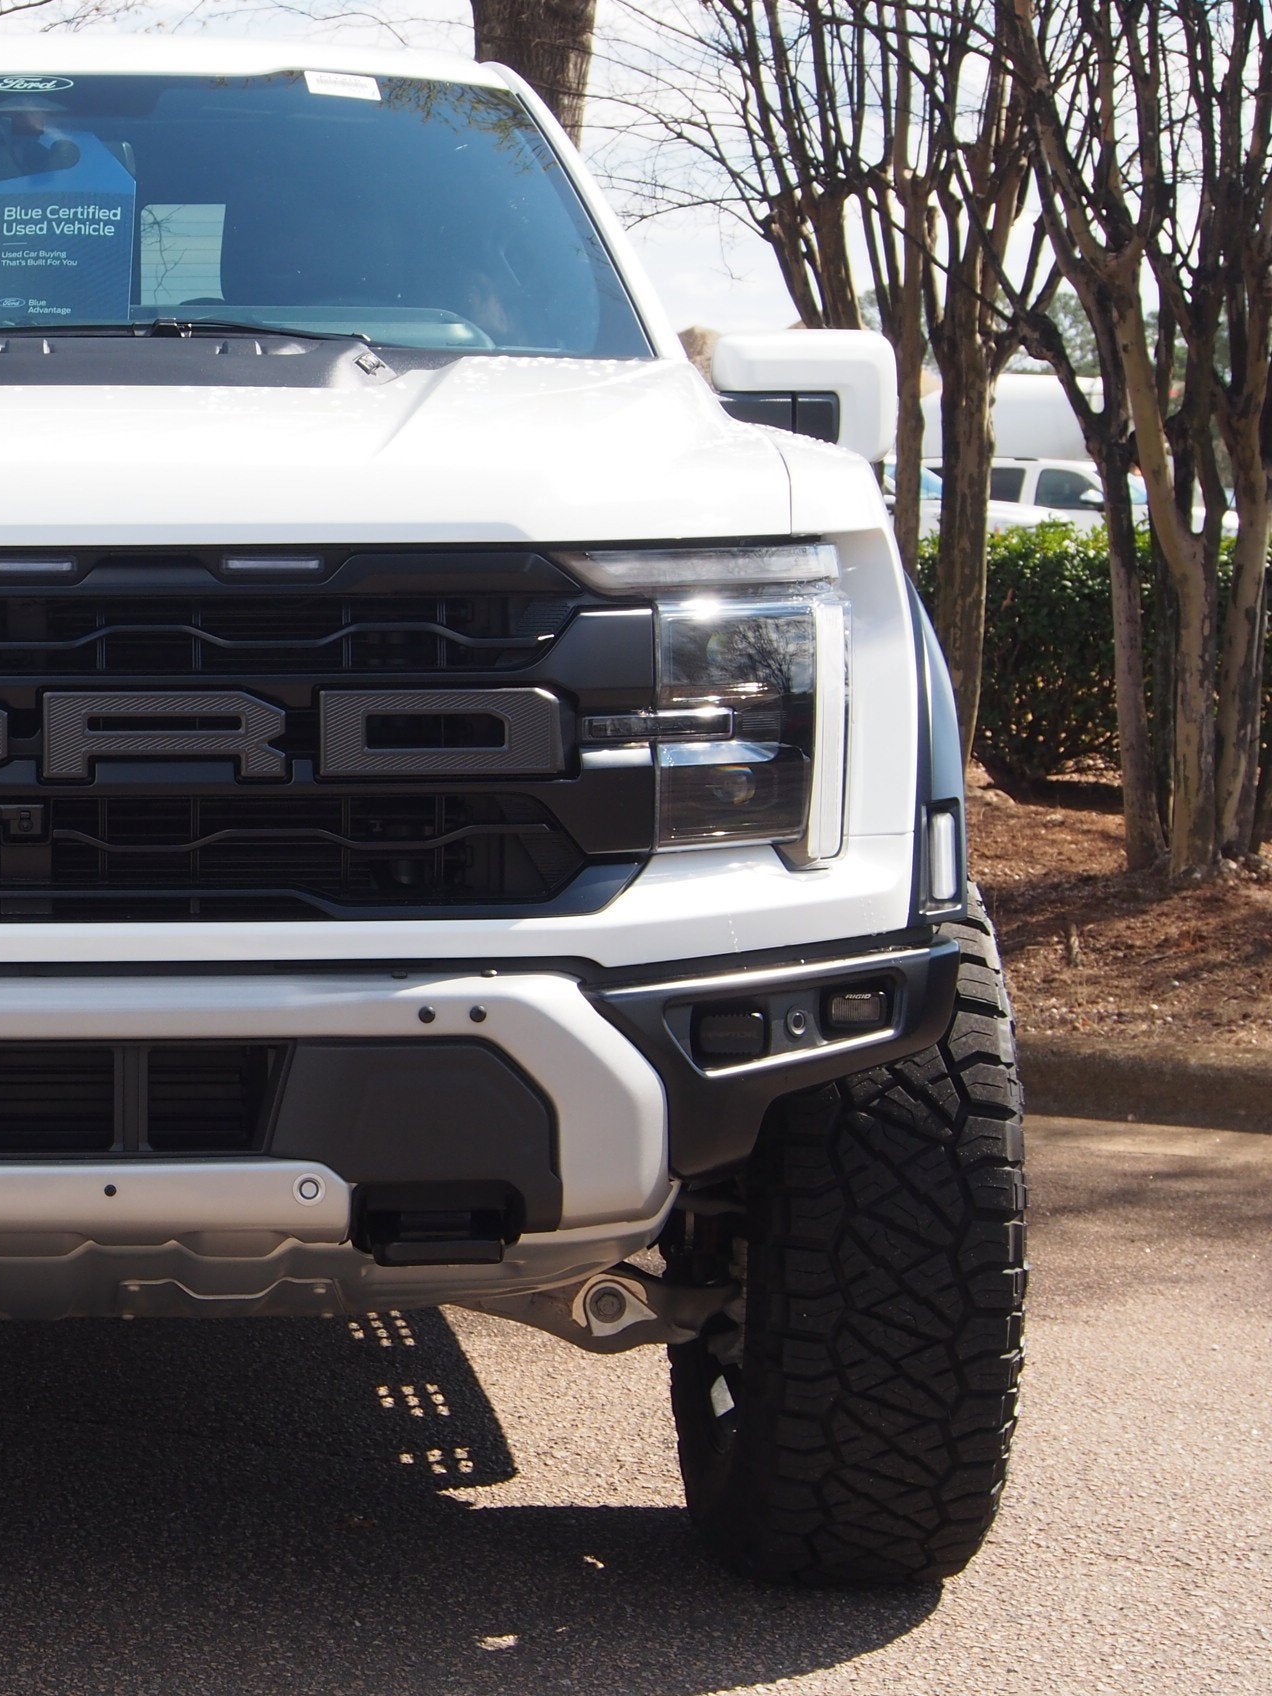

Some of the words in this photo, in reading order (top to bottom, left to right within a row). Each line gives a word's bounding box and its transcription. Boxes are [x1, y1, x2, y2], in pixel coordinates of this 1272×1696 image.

[3, 206, 43, 221] Blue
[46, 205, 122, 221] Certified
[2, 221, 47, 236] Used
[51, 221, 116, 236] Vehicle
[23, 250, 38, 258] Car
[39, 250, 67, 259] Buying
[2, 299, 21, 307] Ford
[28, 306, 72, 315] Advantage
